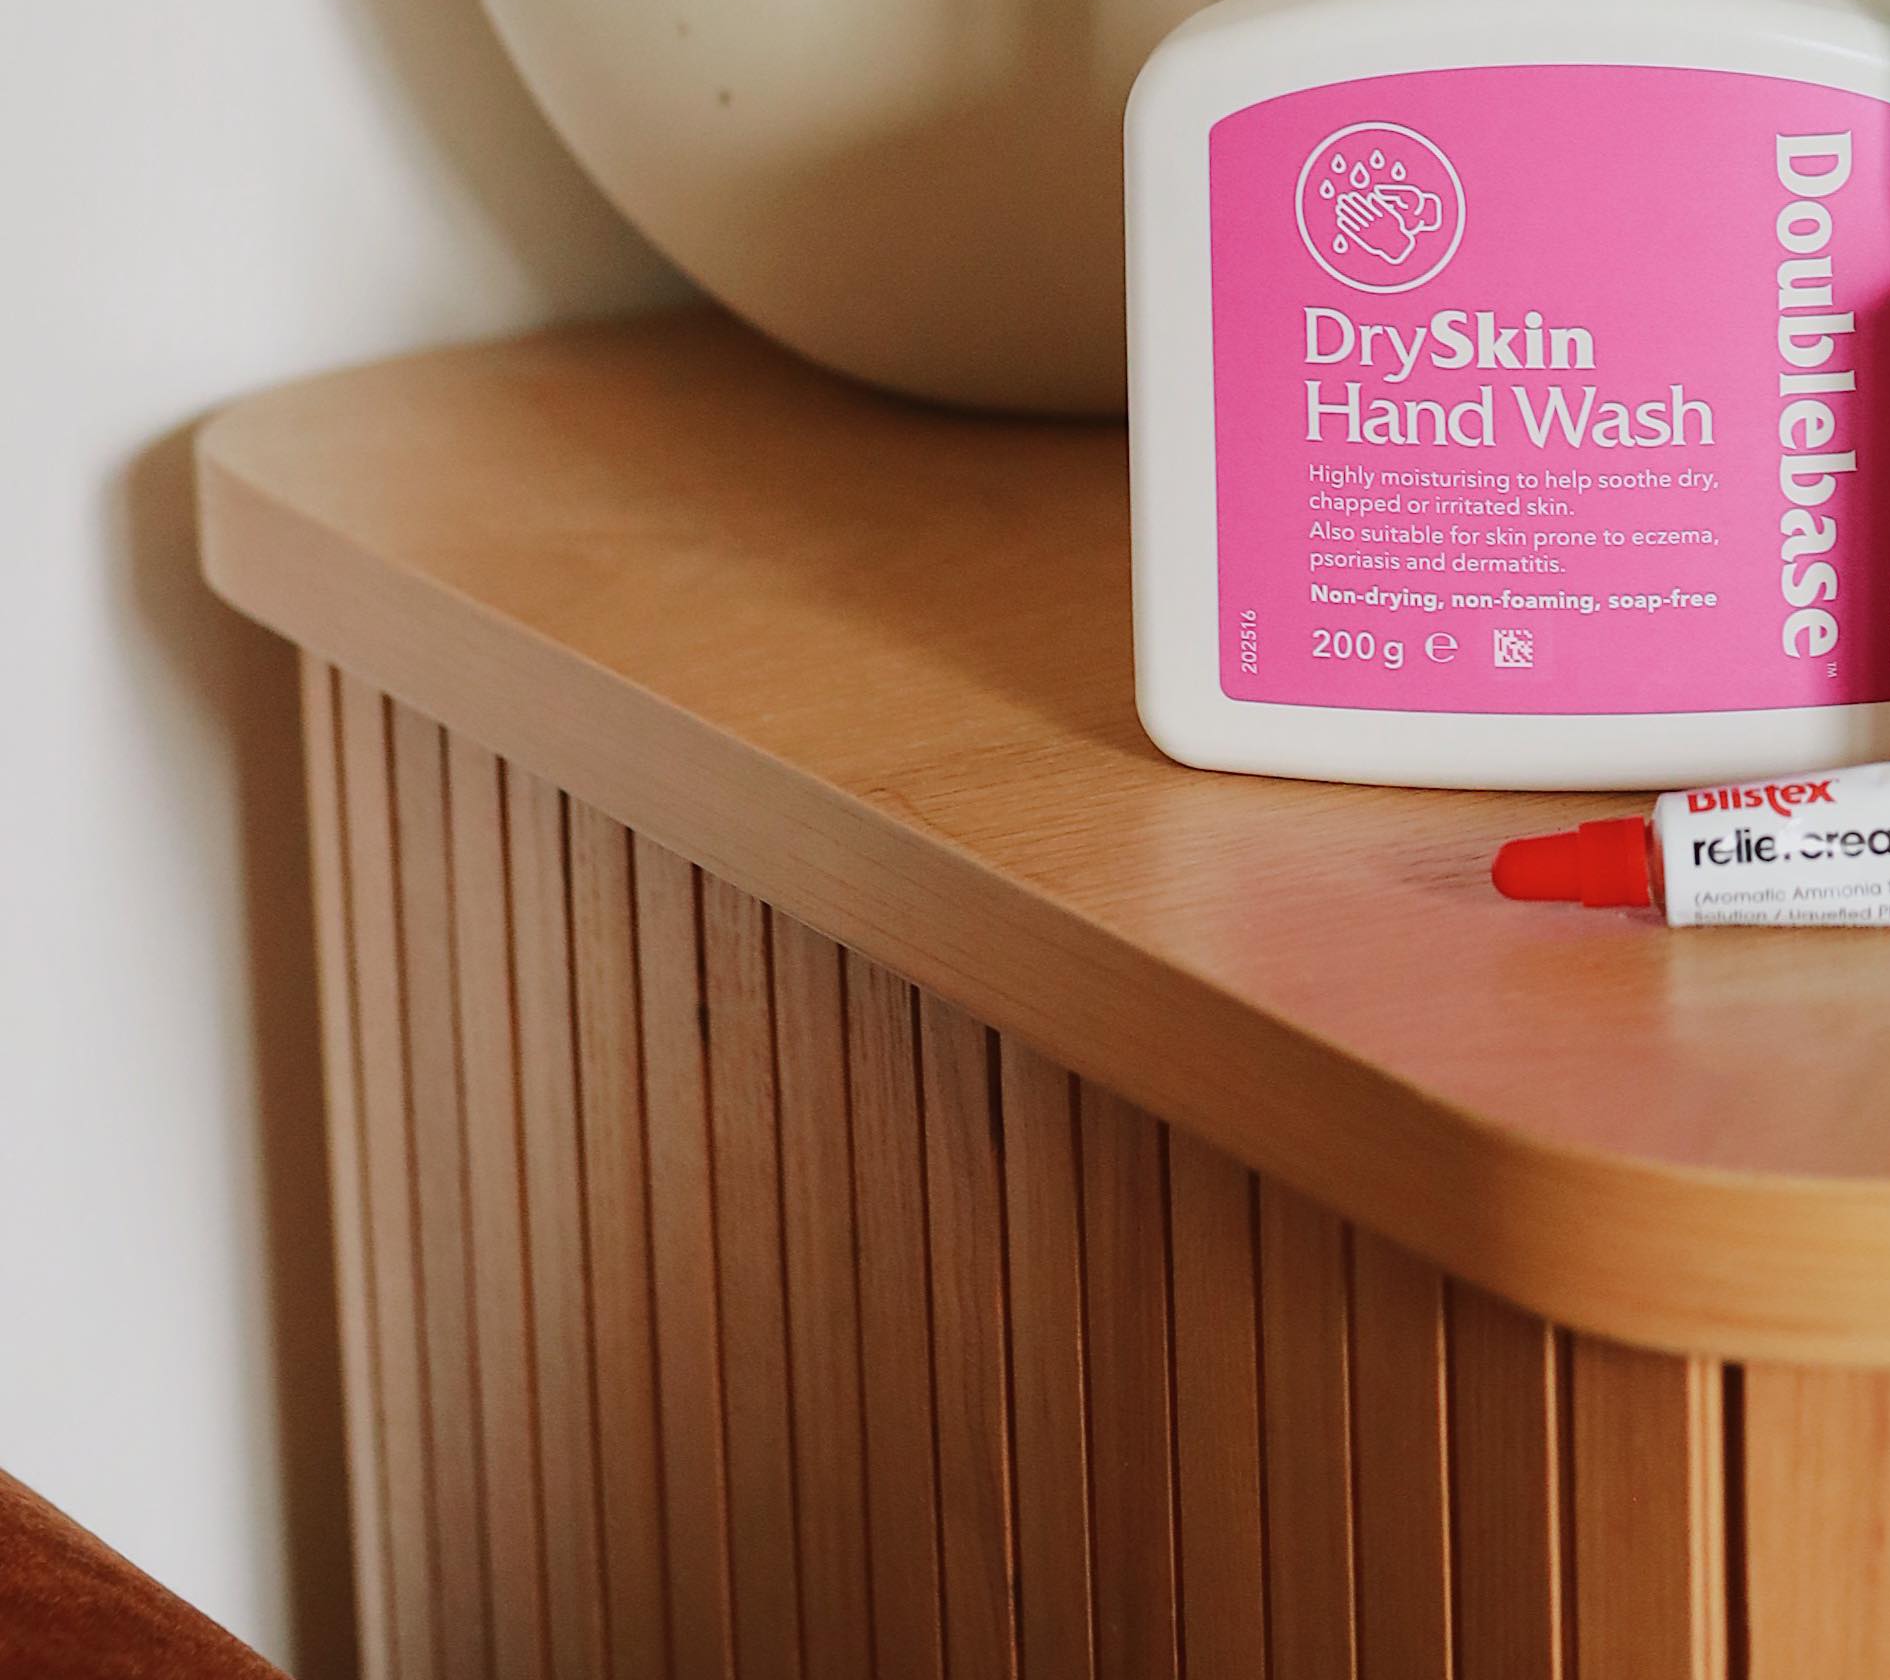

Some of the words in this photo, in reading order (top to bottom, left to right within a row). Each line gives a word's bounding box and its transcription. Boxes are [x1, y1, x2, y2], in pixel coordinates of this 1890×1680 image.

[1303, 306, 1597, 383] DrySkin
[1303, 379, 1497, 446] Hand
[1511, 383, 1716, 449] Wash
[1308, 463, 1375, 490] Highly
[1380, 468, 1511, 494] moisturising
[1516, 472, 1539, 489] to
[1545, 468, 1592, 495] help
[1598, 468, 1672, 489] soothe
[1678, 468, 1720, 492] dry,
[1308, 491, 1401, 517] chapped
[1407, 499, 1430, 514] or
[1435, 496, 1521, 516] irritated
[1526, 496, 1575, 516] skin.
[1308, 520, 1356, 541] Also
[1360, 524, 1444, 544] suitable
[1450, 525, 1481, 545] for
[1485, 526, 1527, 546] skin
[1533, 531, 1598, 552] prone
[1603, 529, 1625, 546] to
[1631, 529, 1720, 546] eczema,
[1309, 550, 1401, 572] psoriasis
[1406, 551, 1446, 571] and
[1452, 552, 1566, 574] dermatitis.
[1310, 583, 1446, 612] Non-drying,
[1451, 589, 1601, 614] non-foaming,
[1608, 588, 1718, 613] soap-free
[1240, 609, 1257, 674] 202516
[1311, 629, 1376, 661] 200
[1792, 882, 1882, 901] Ammonia
